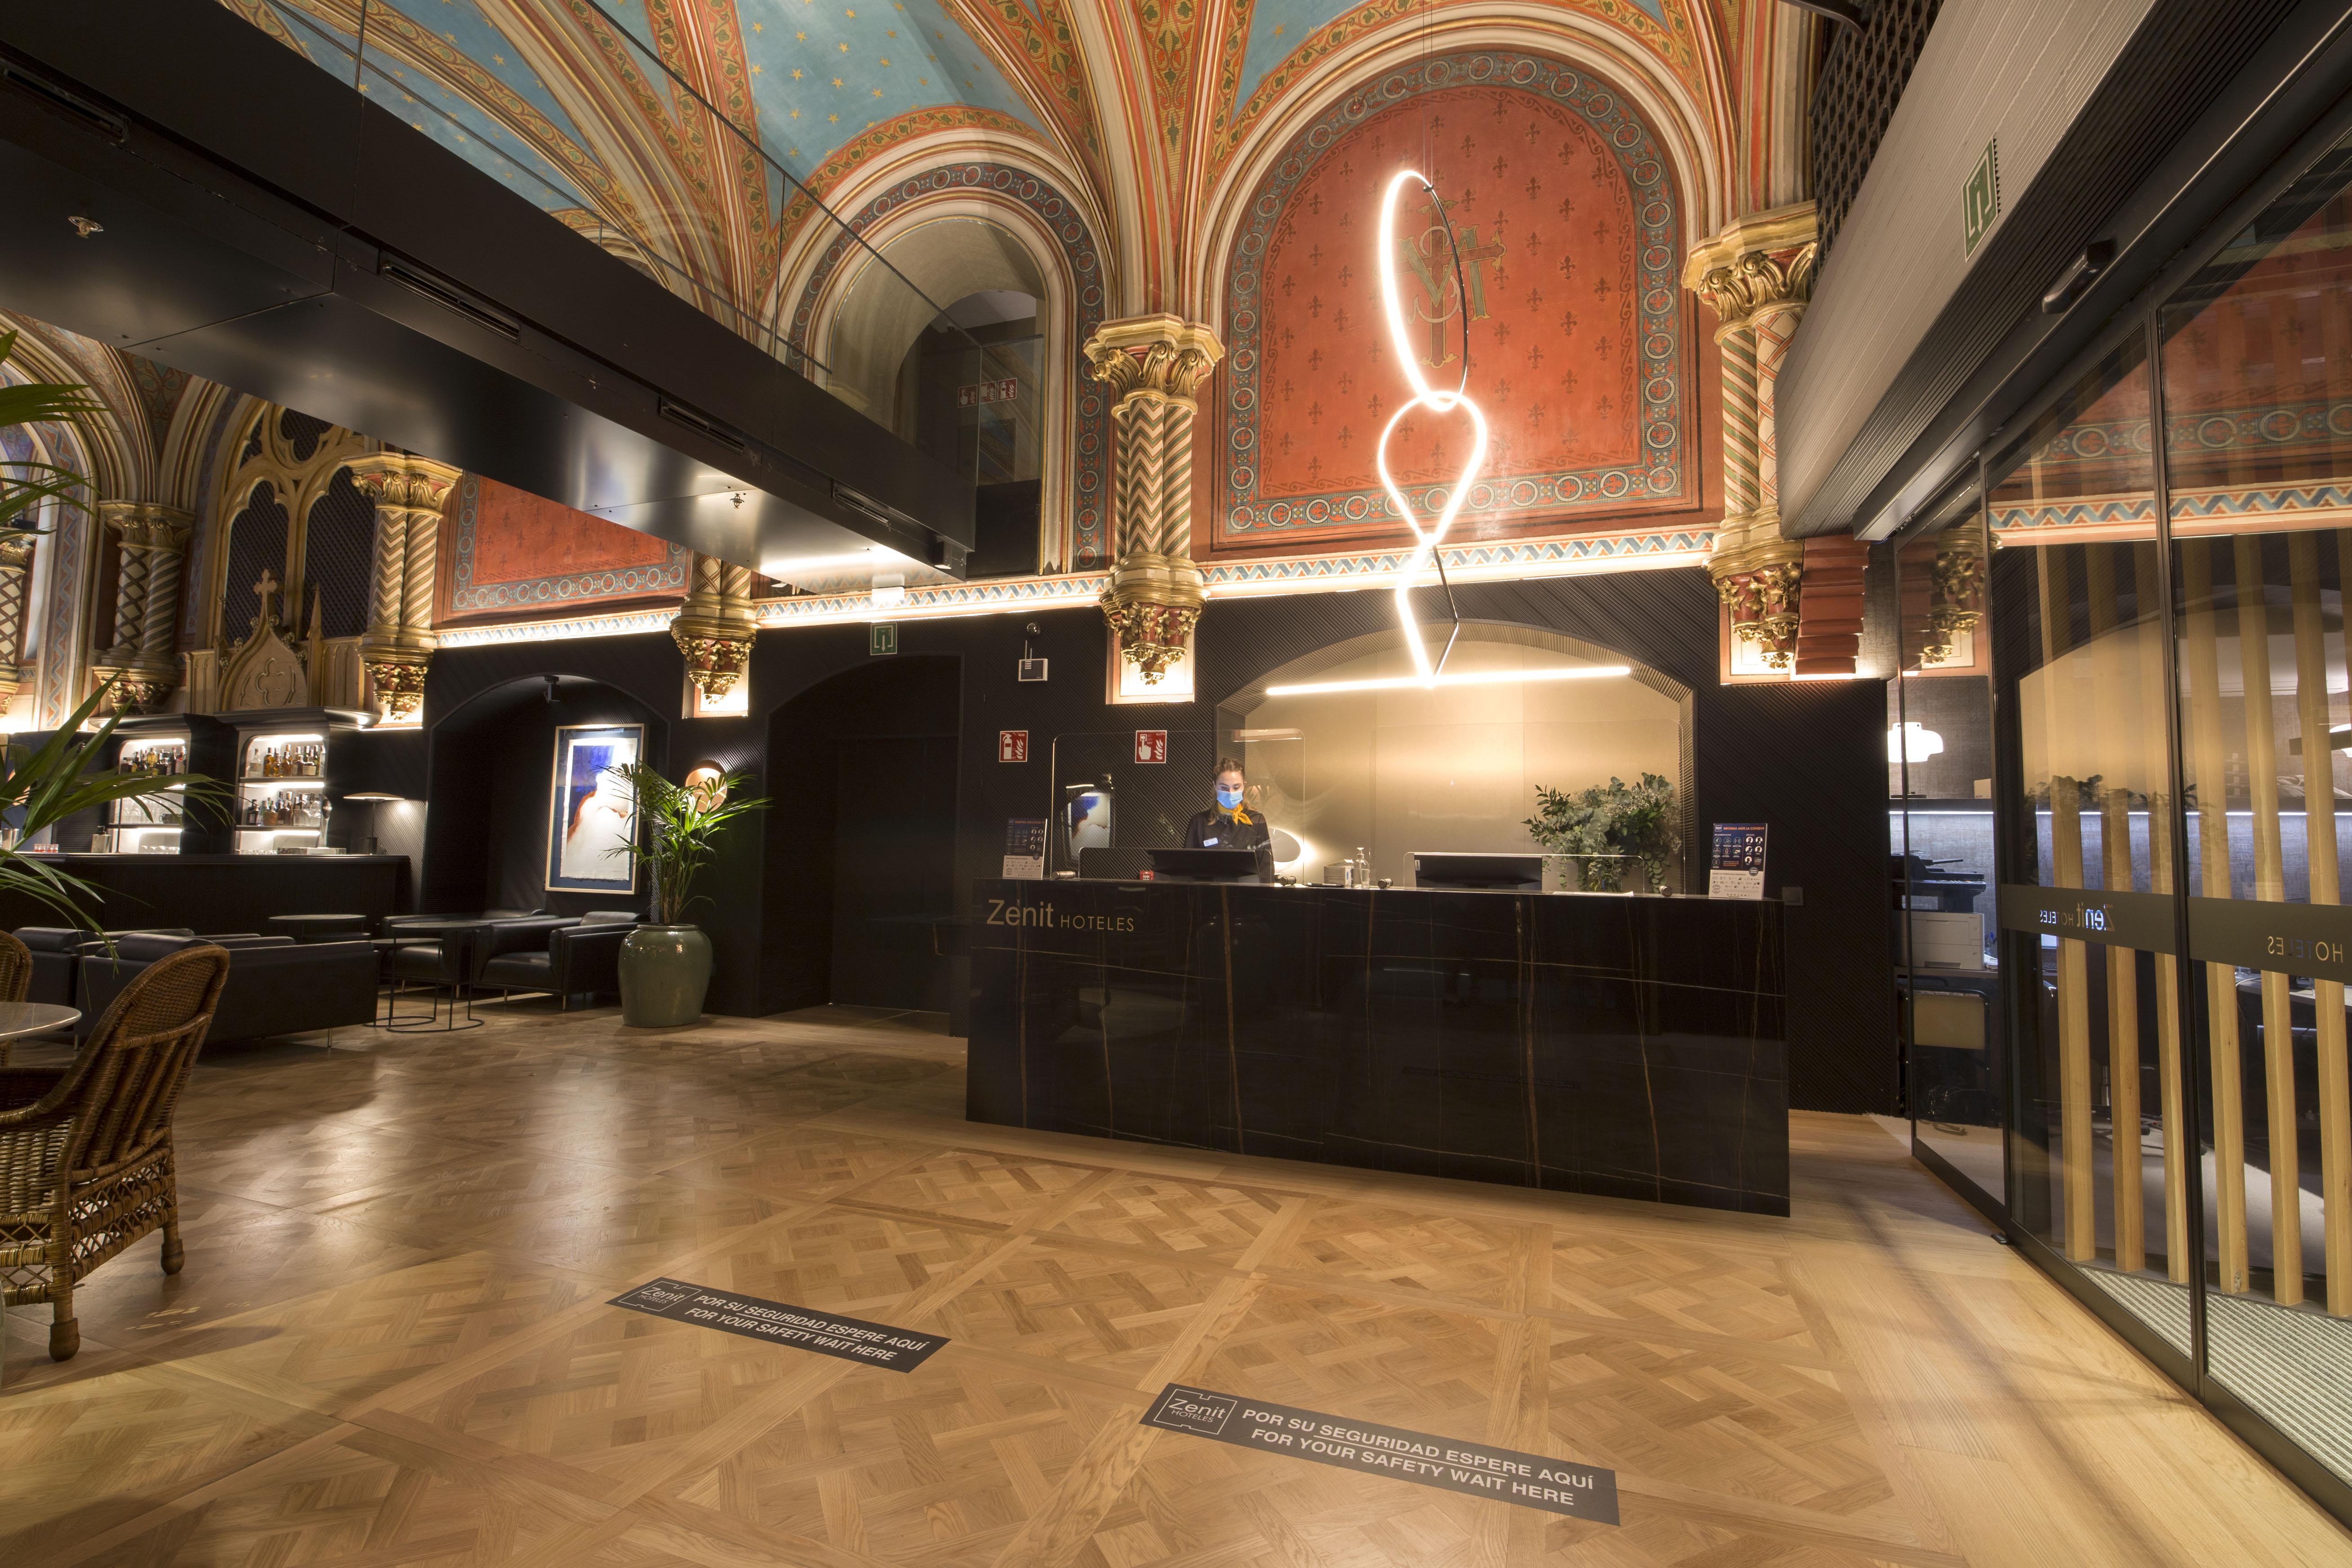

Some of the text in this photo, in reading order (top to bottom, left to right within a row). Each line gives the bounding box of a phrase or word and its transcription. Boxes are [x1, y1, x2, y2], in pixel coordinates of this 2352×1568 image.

[987, 899, 1134, 932] Zenit HOTELES
[638, 1294, 669, 1304] HOTELES
[641, 1287, 686, 1301] Zenit
[685, 1308, 898, 1360] FOR YOUR SAFETY WAIT HERE
[693, 1295, 931, 1351] POR SU SEGURIDAD ESPERE AQUÍ
[1168, 1398, 1226, 1419] Zenit
[1171, 1409, 1214, 1423] HOTELES
[1242, 1409, 1594, 1490] POR SU SEGURIDAD ESPERE AQUÍ
[1251, 1429, 1574, 1506] FOR YOUR SAFETY WAIT HERE
